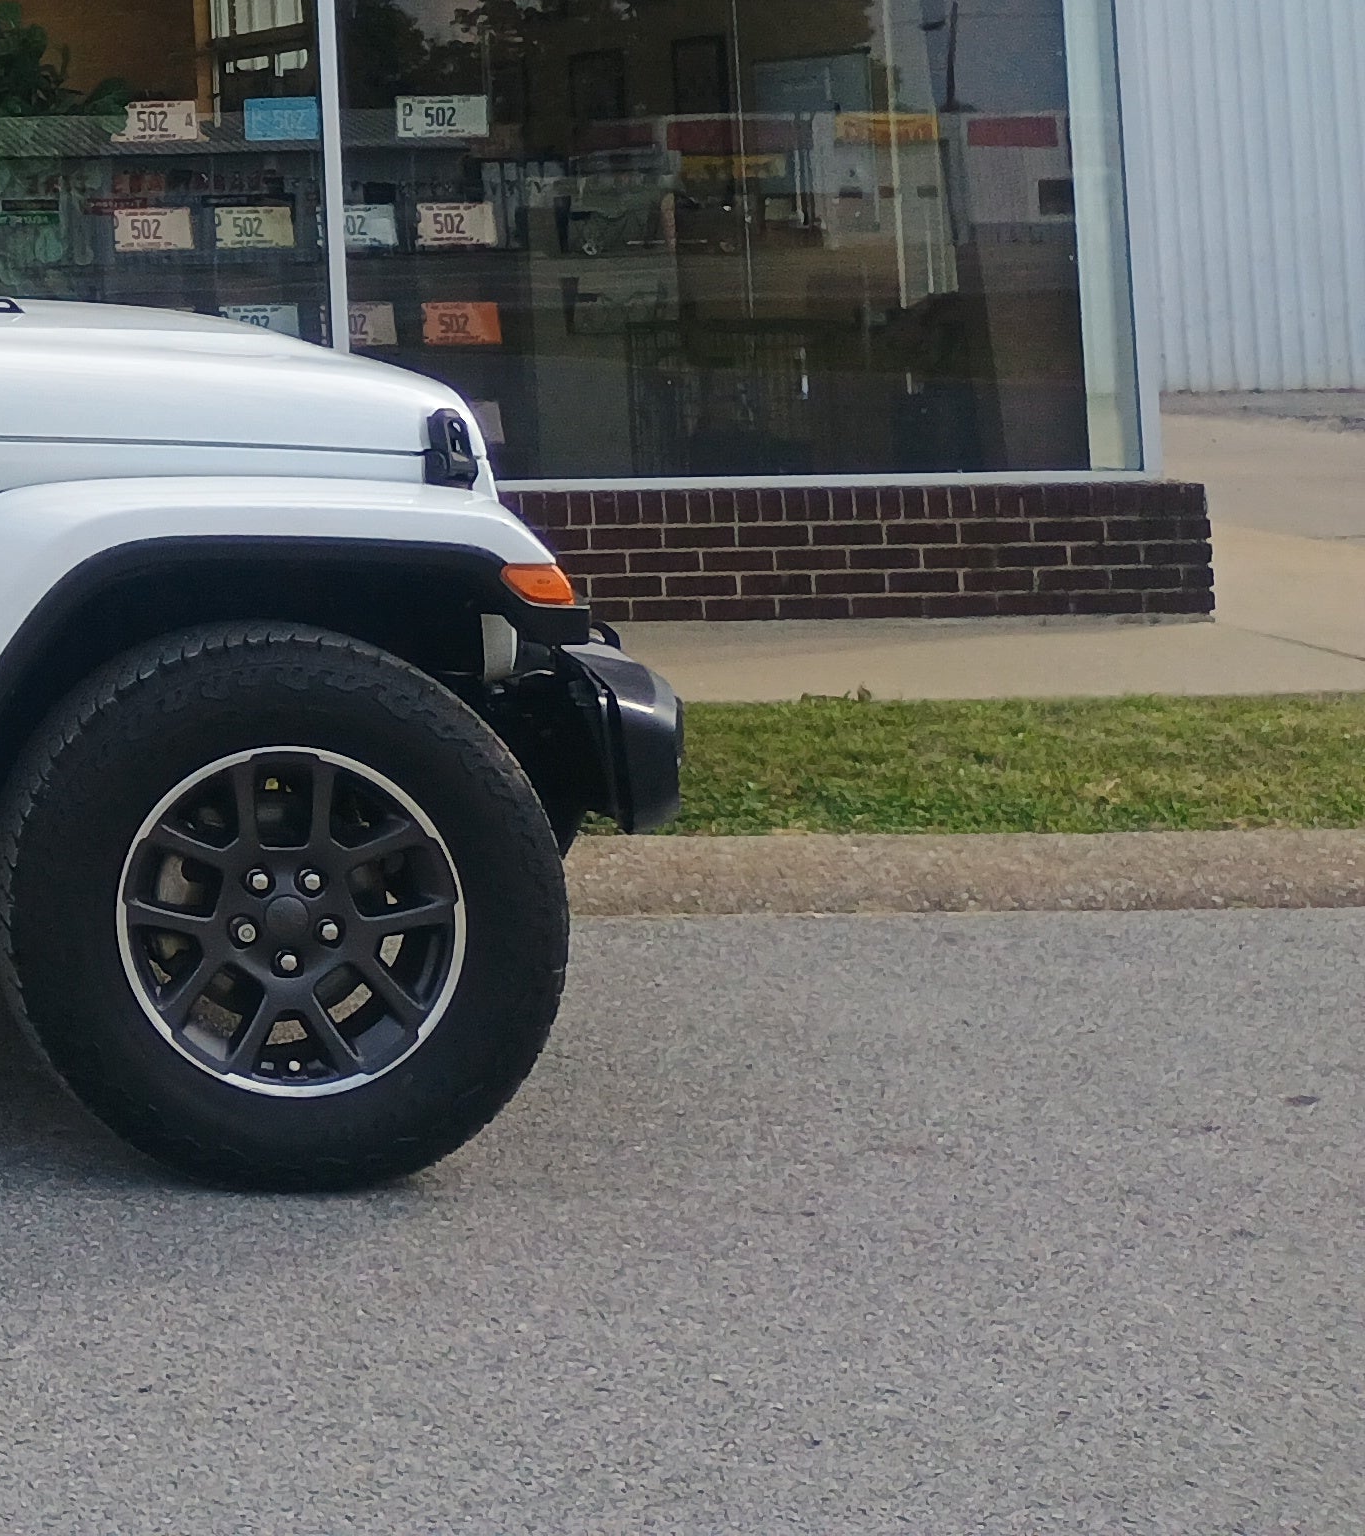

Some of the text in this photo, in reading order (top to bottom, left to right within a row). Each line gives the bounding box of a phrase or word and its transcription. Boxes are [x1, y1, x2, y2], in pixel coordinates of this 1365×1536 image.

[136, 110, 169, 133] 502
[424, 106, 457, 127] 502
[130, 218, 163, 240] 502
[232, 216, 265, 238] 502
[345, 215, 368, 235] 02
[432, 212, 466, 235] 502
